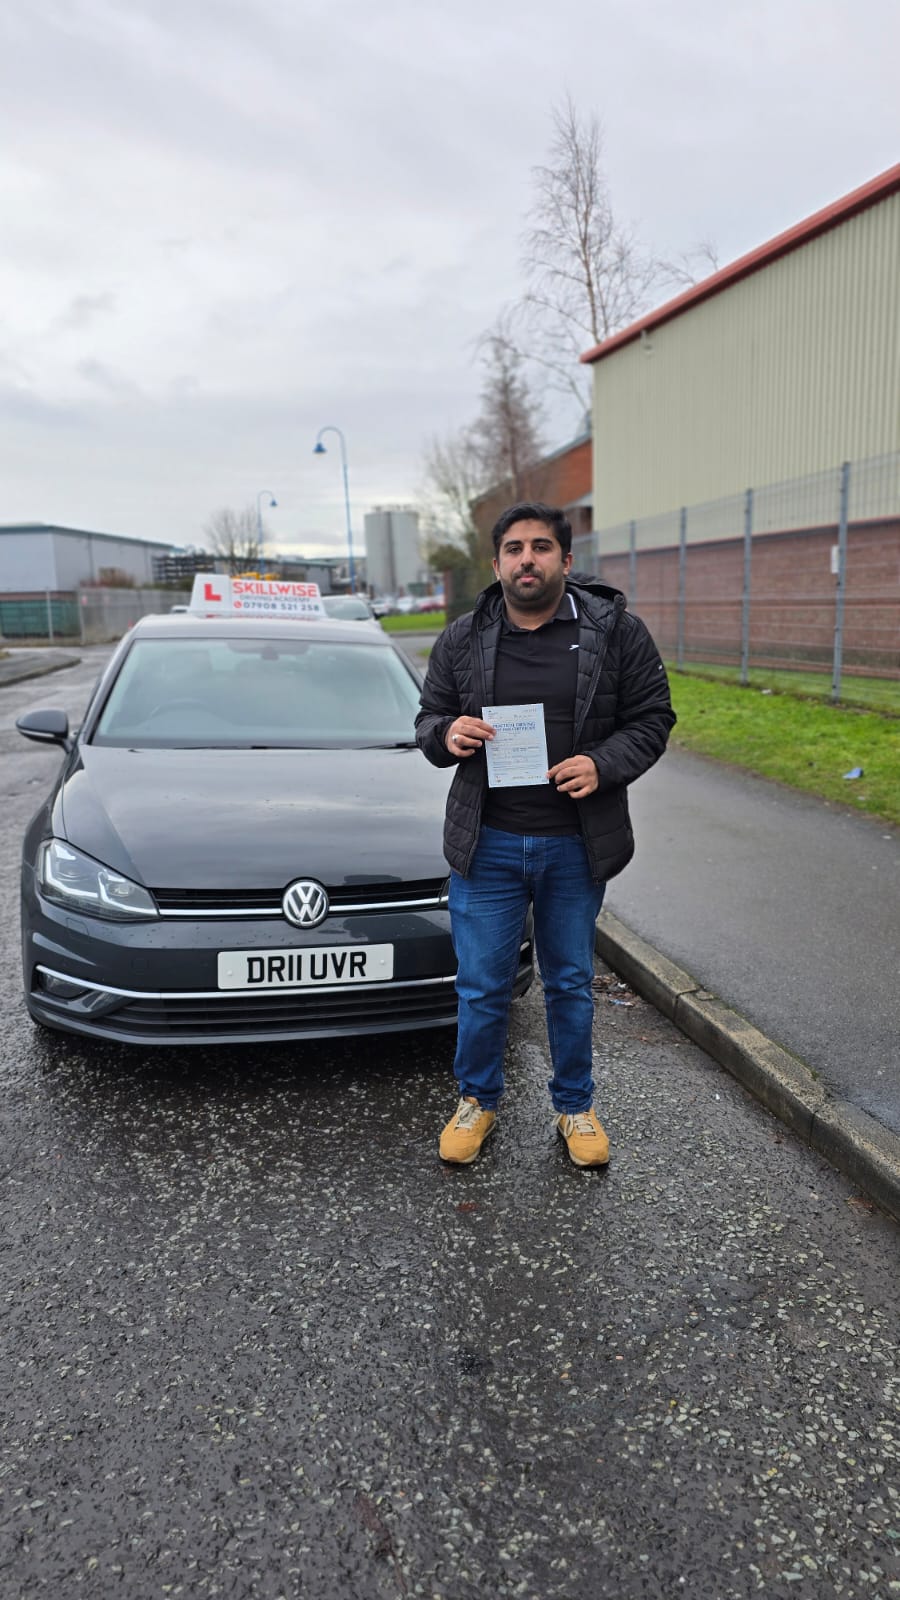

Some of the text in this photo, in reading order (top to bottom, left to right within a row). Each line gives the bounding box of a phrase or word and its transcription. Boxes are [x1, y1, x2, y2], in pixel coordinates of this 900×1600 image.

[204, 583, 222, 601] L
[232, 581, 318, 597] SKILLWISE
[274, 595, 311, 603] ACADEMY
[243, 602, 320, 613] 07908 521 258
[247, 951, 367, 983] DR11 UVR
